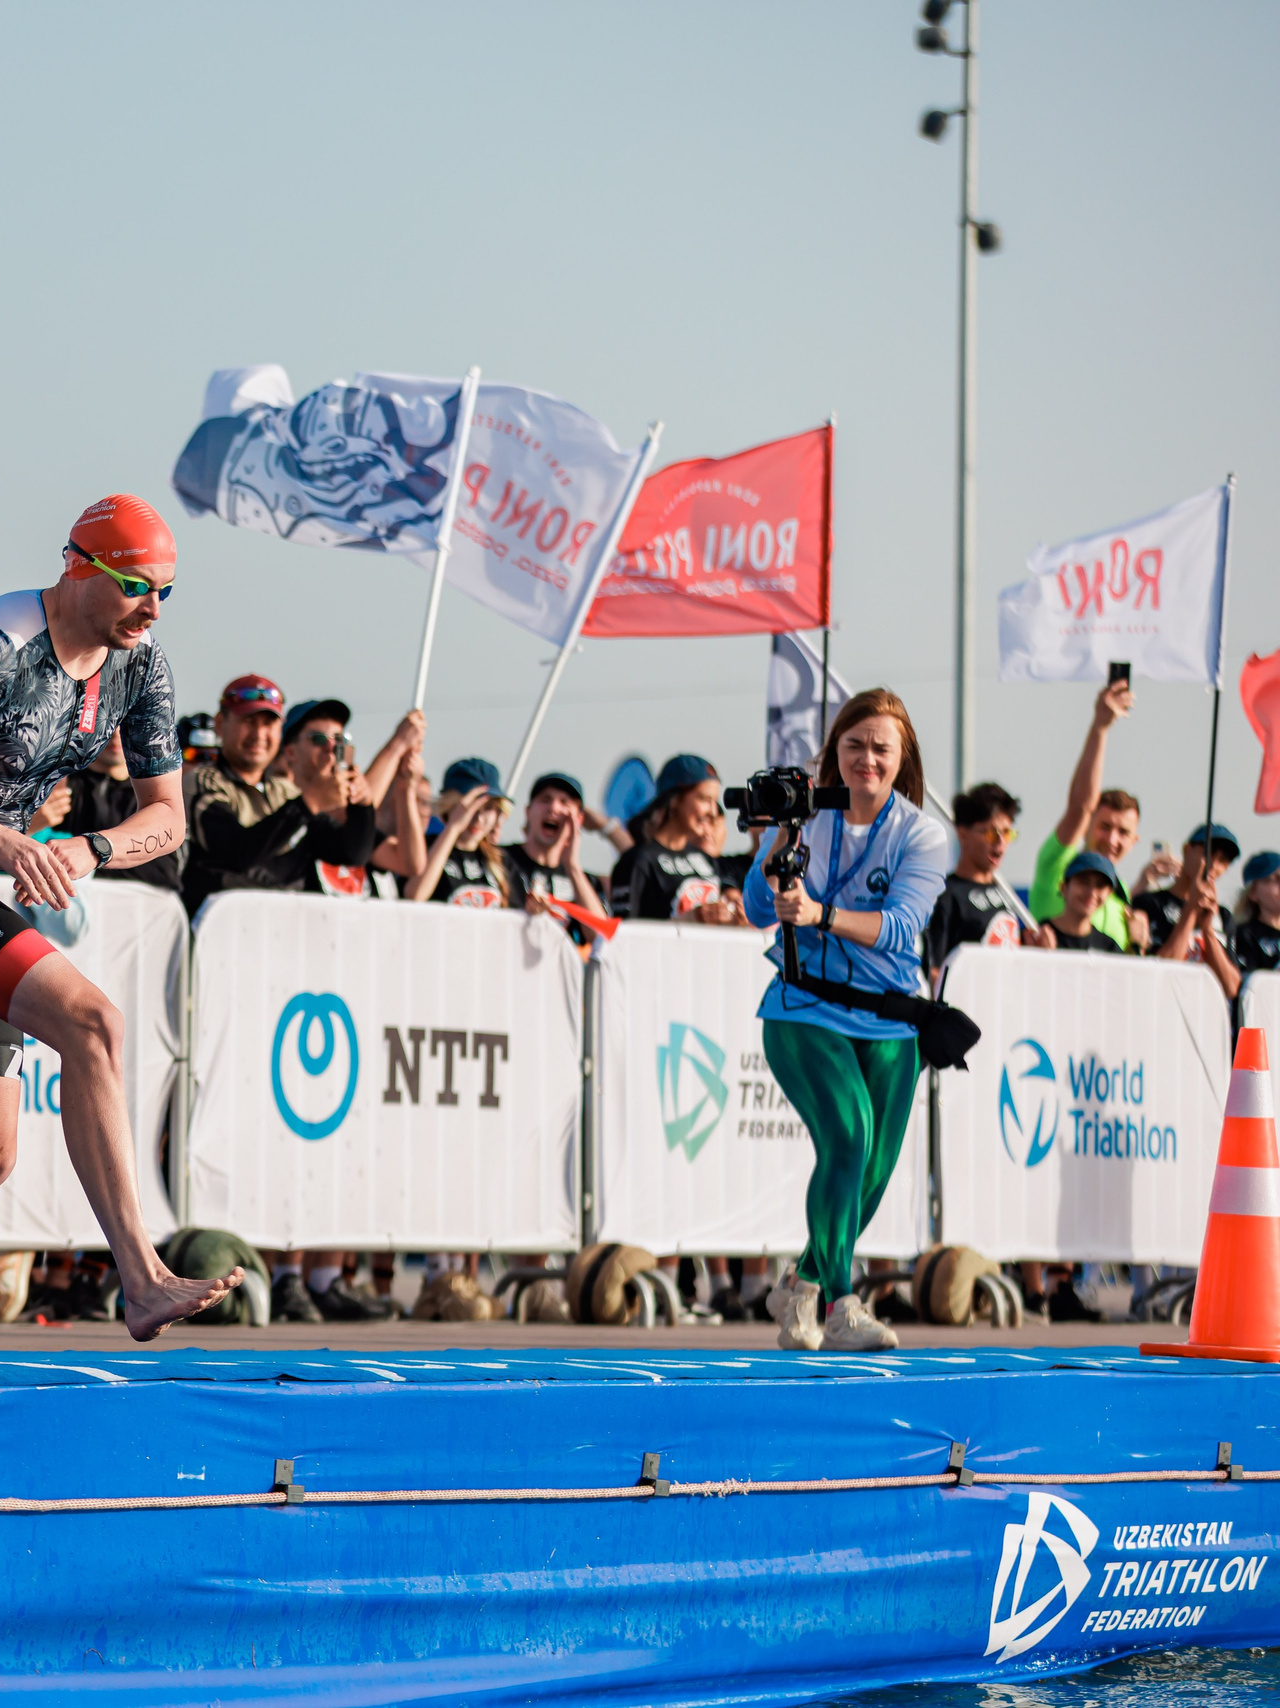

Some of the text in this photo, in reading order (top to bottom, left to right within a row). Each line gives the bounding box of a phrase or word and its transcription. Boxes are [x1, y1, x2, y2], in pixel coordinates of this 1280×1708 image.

[383, 1026, 509, 1109] NTT
[1068, 1055, 1144, 1105] World
[738, 1120, 808, 1140] FEDERAT
[1068, 1109, 1178, 1162] Triathlon
[1113, 1521, 1234, 1551] UZBEKISTAN
[1097, 1556, 1268, 1598] TRIATHLON
[1080, 1605, 1207, 1633] FEDERATION
